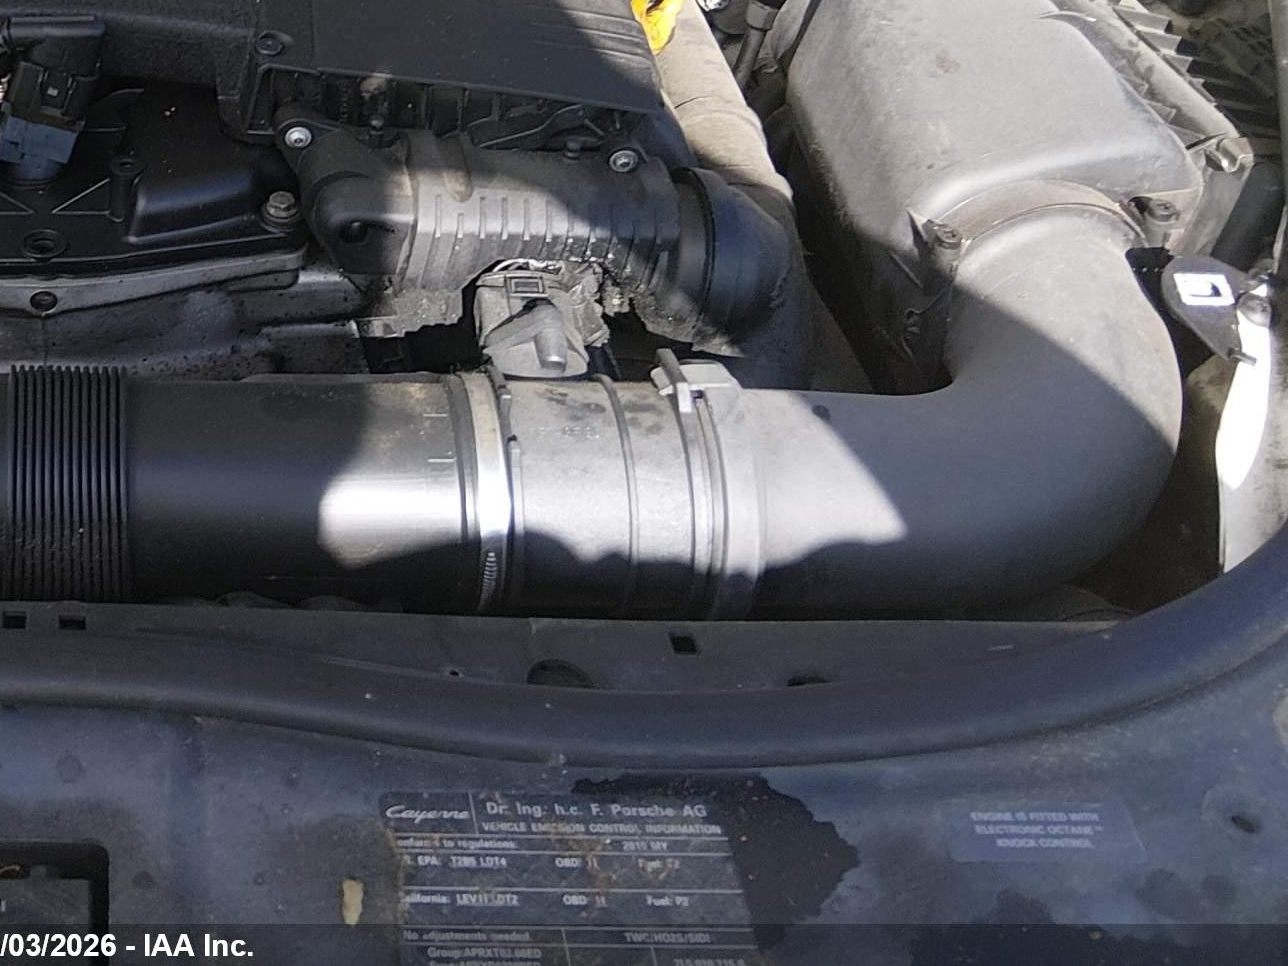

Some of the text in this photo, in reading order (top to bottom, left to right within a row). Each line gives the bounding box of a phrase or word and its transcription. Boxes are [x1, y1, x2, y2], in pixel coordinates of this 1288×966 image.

[386, 805, 470, 824] Cayenne
[486, 802, 508, 815] Dr.
[591, 803, 604, 817] F.
[611, 804, 675, 817] Porsche
[683, 805, 708, 817] AG
[481, 822, 722, 835] VEHICLE EMISSION CONTROL INFORMATION
